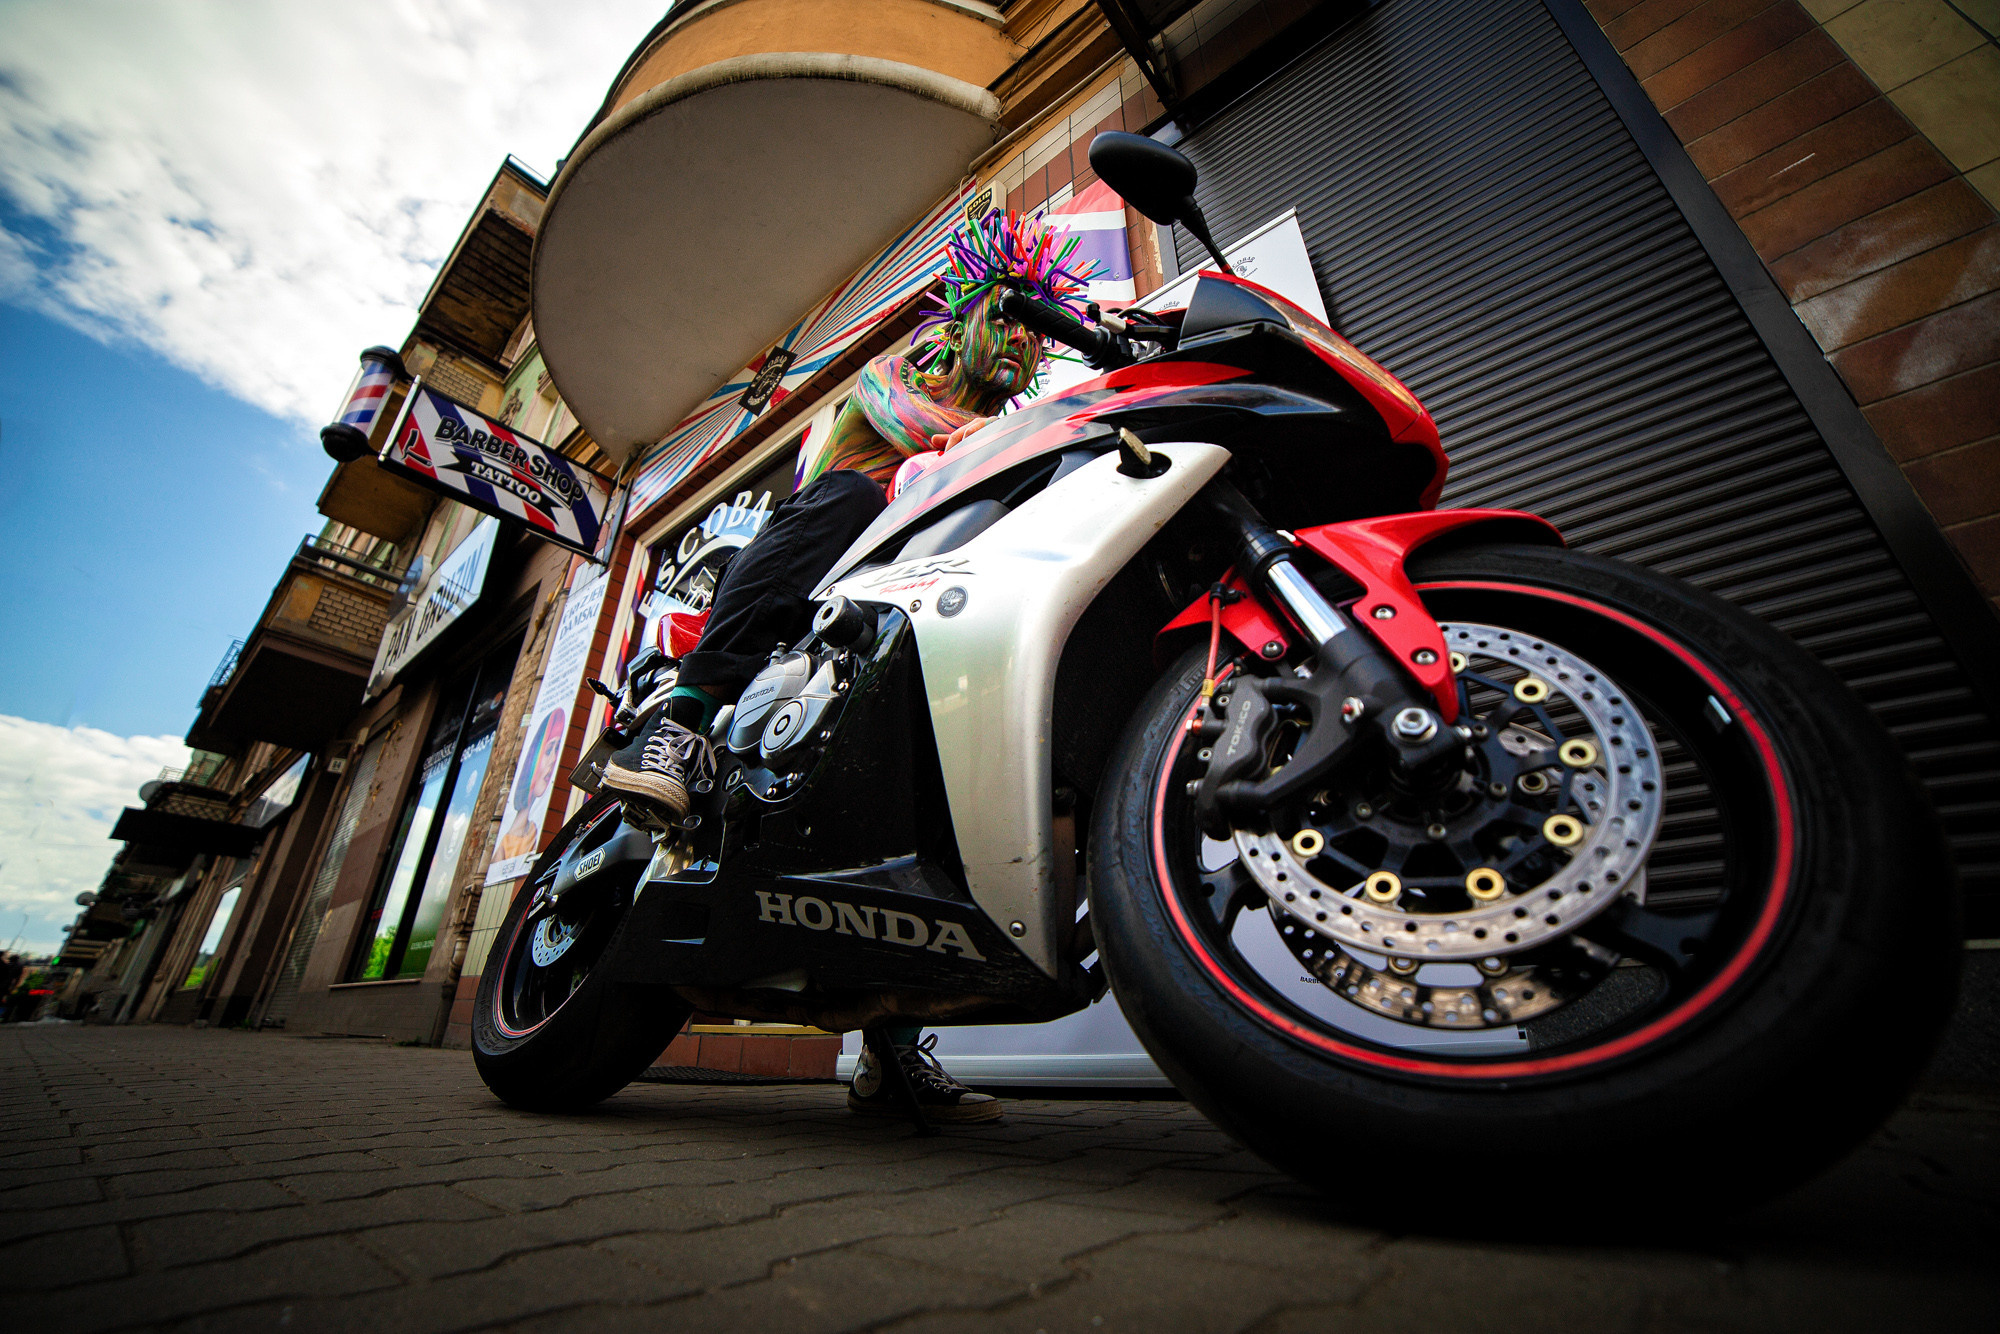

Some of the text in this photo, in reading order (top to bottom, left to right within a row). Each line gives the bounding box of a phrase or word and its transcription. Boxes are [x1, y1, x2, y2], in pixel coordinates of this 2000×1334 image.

[434, 415, 584, 510] BARBER SHOP
[471, 461, 541, 504] TATTOO
[637, 490, 772, 618] ESCOBA
[382, 541, 484, 670] PAN GRUZIN
[560, 603, 600, 640] DAMSKI
[742, 686, 775, 703] HONDA
[578, 852, 602, 875] SHOEI
[755, 890, 987, 962] HONDA
